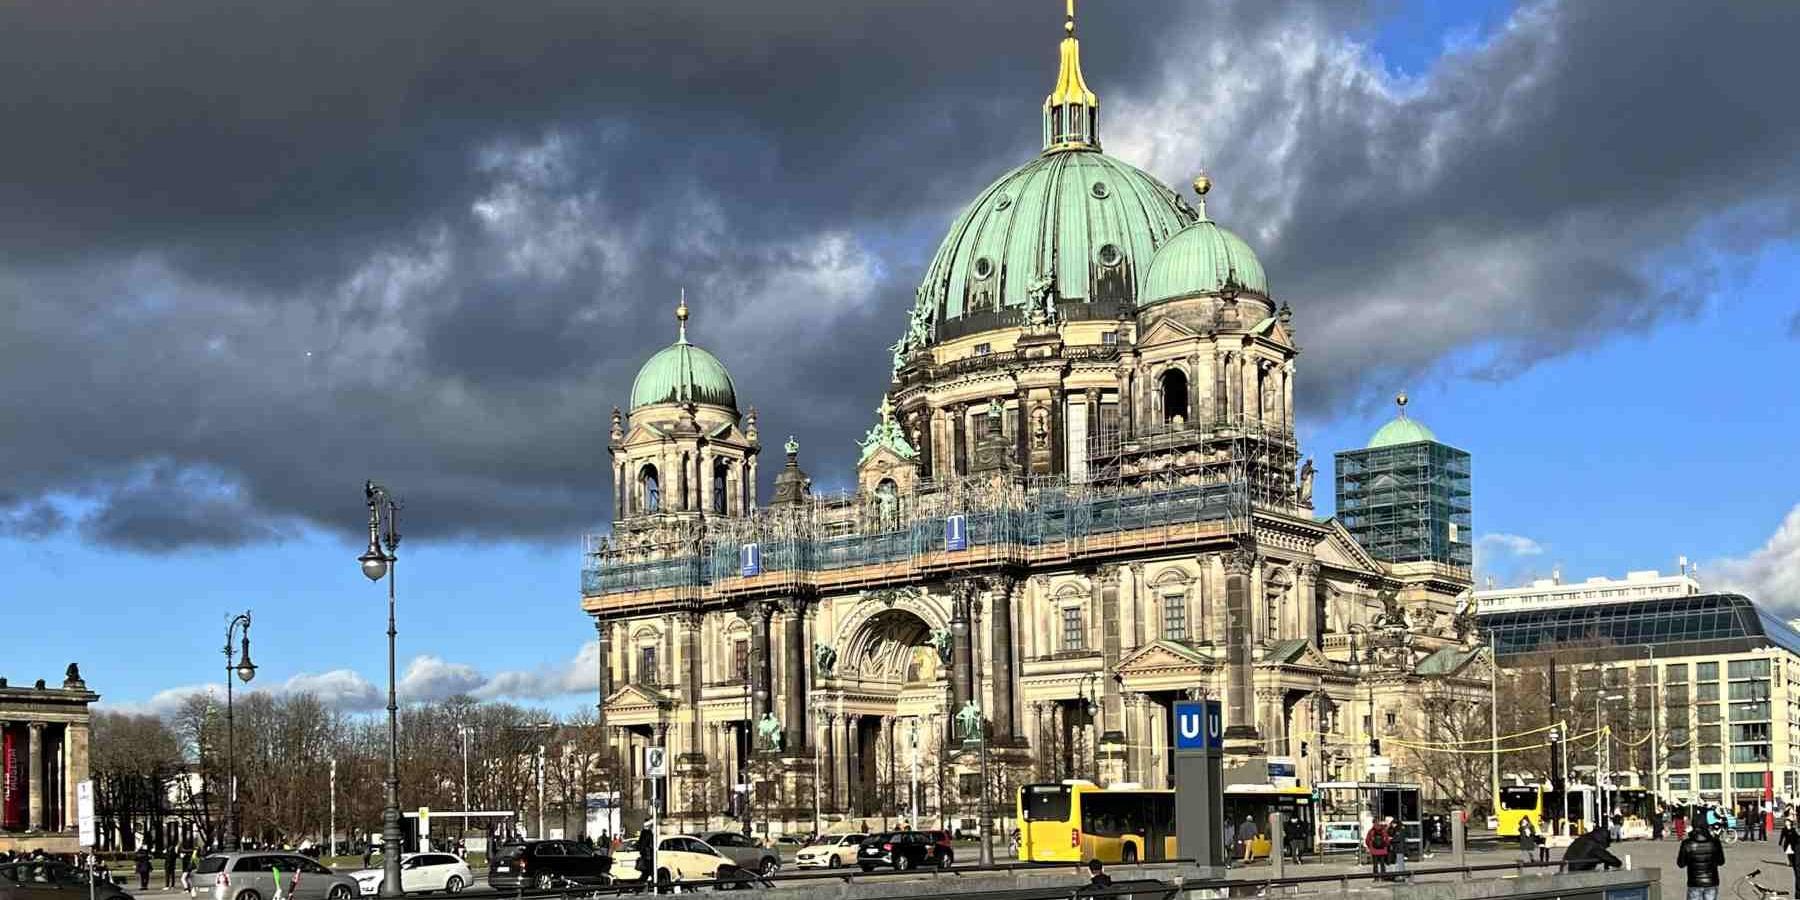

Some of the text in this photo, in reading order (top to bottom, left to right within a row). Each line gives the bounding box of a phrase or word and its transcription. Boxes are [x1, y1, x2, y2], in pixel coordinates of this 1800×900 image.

[948, 515, 964, 539] T
[743, 543, 757, 566] T
[1181, 714, 1199, 739] U
[1209, 714, 1219, 738] U
